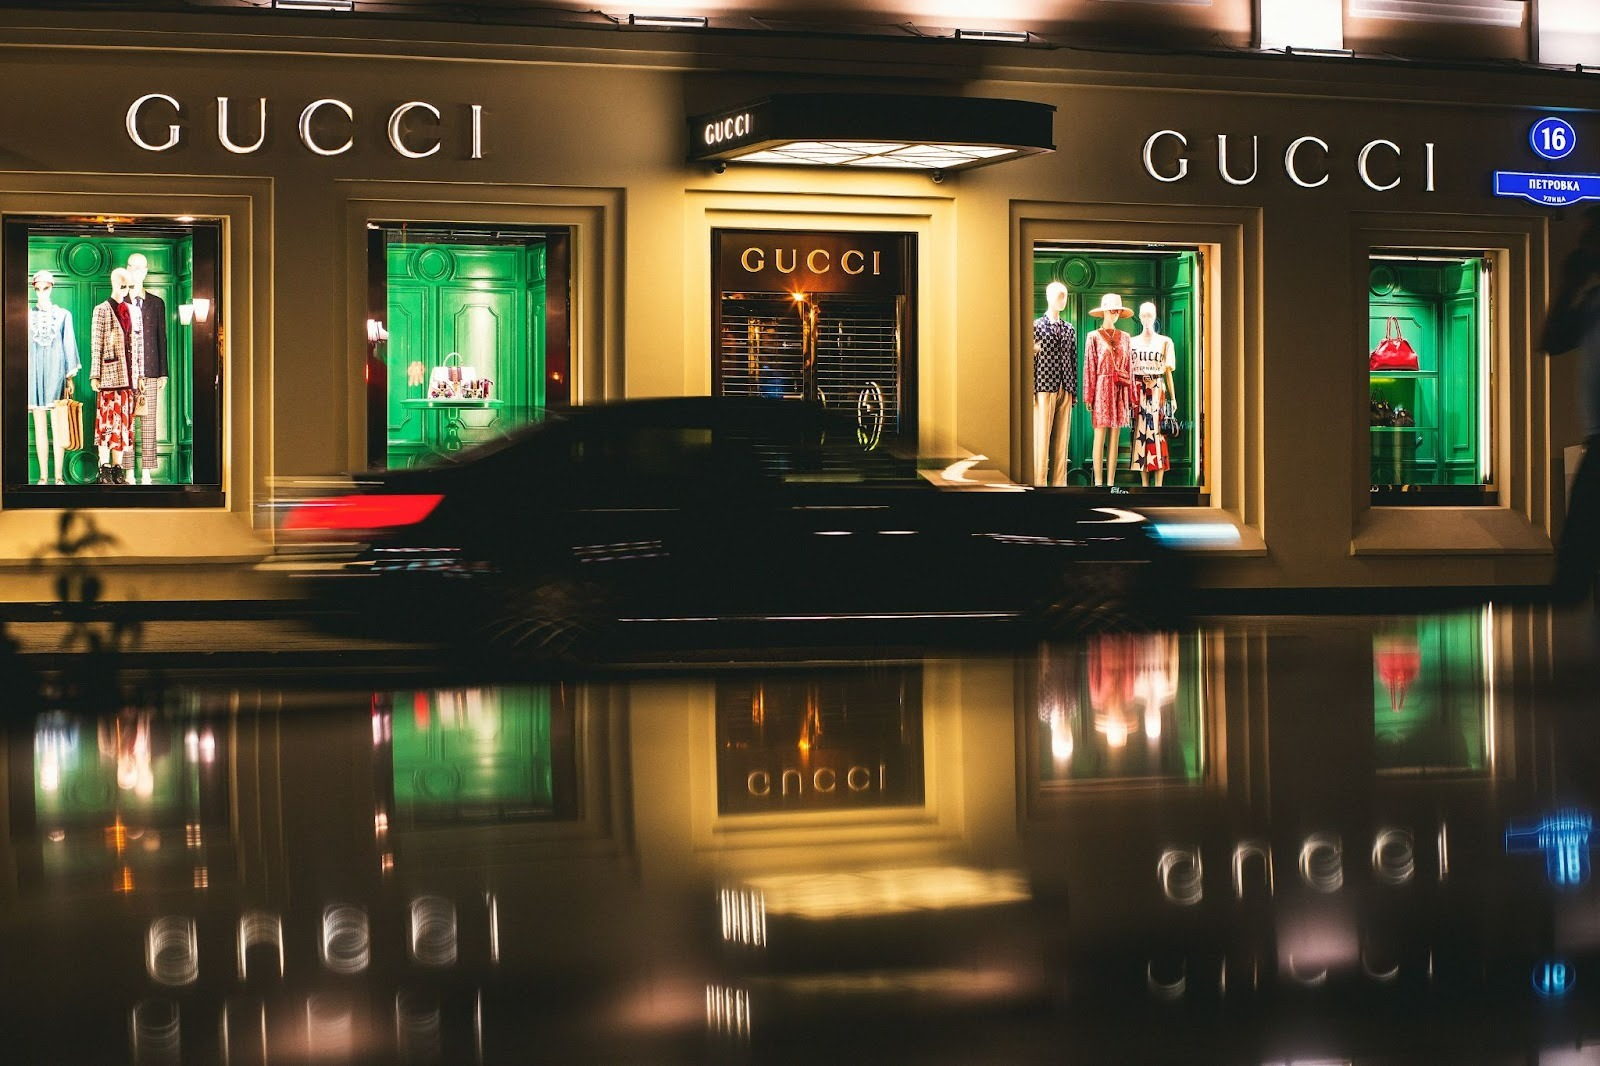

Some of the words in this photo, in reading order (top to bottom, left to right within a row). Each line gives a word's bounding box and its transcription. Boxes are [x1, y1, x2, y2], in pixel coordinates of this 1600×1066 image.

[125, 93, 481, 159] GUCCI
[705, 113, 750, 145] GUCCI
[1541, 127, 1566, 150] 16
[1143, 130, 1434, 191] GUCCI
[1529, 179, 1580, 191] ПЕТРОВКА
[1543, 195, 1566, 203] УЛИЦА
[741, 247, 880, 275] GUCCI
